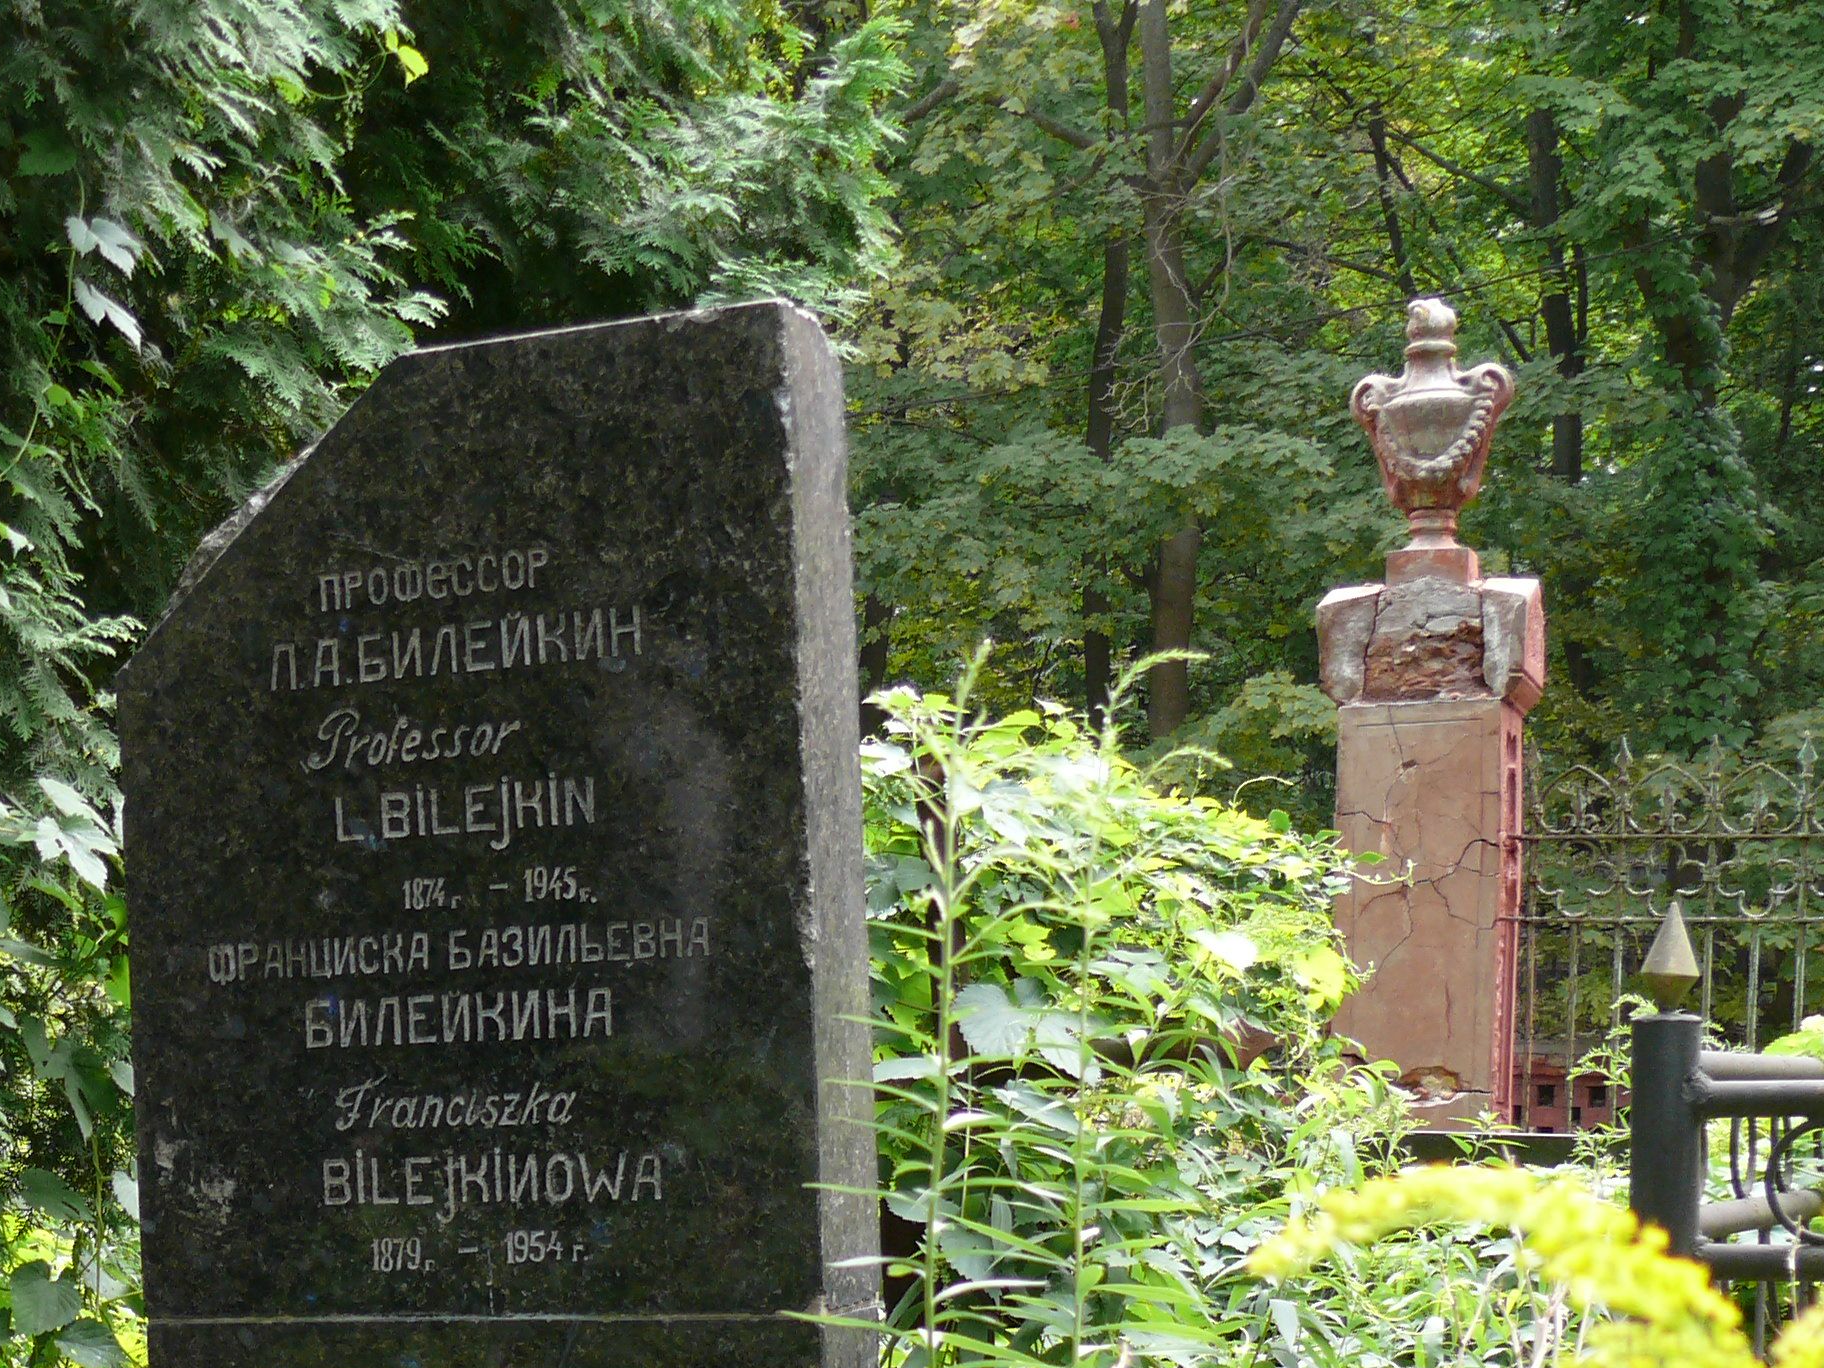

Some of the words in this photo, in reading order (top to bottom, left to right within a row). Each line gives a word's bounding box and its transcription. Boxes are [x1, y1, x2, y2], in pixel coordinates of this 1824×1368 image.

[303, 705, 521, 771] Professor
[207, 931, 430, 986] ФРАНЦИСКА
[448, 915, 711, 972] БАЗИЛЬЕВНА
[304, 986, 614, 1050] БИЛЕЙКИНА
[334, 1074, 578, 1131] Franciszka
